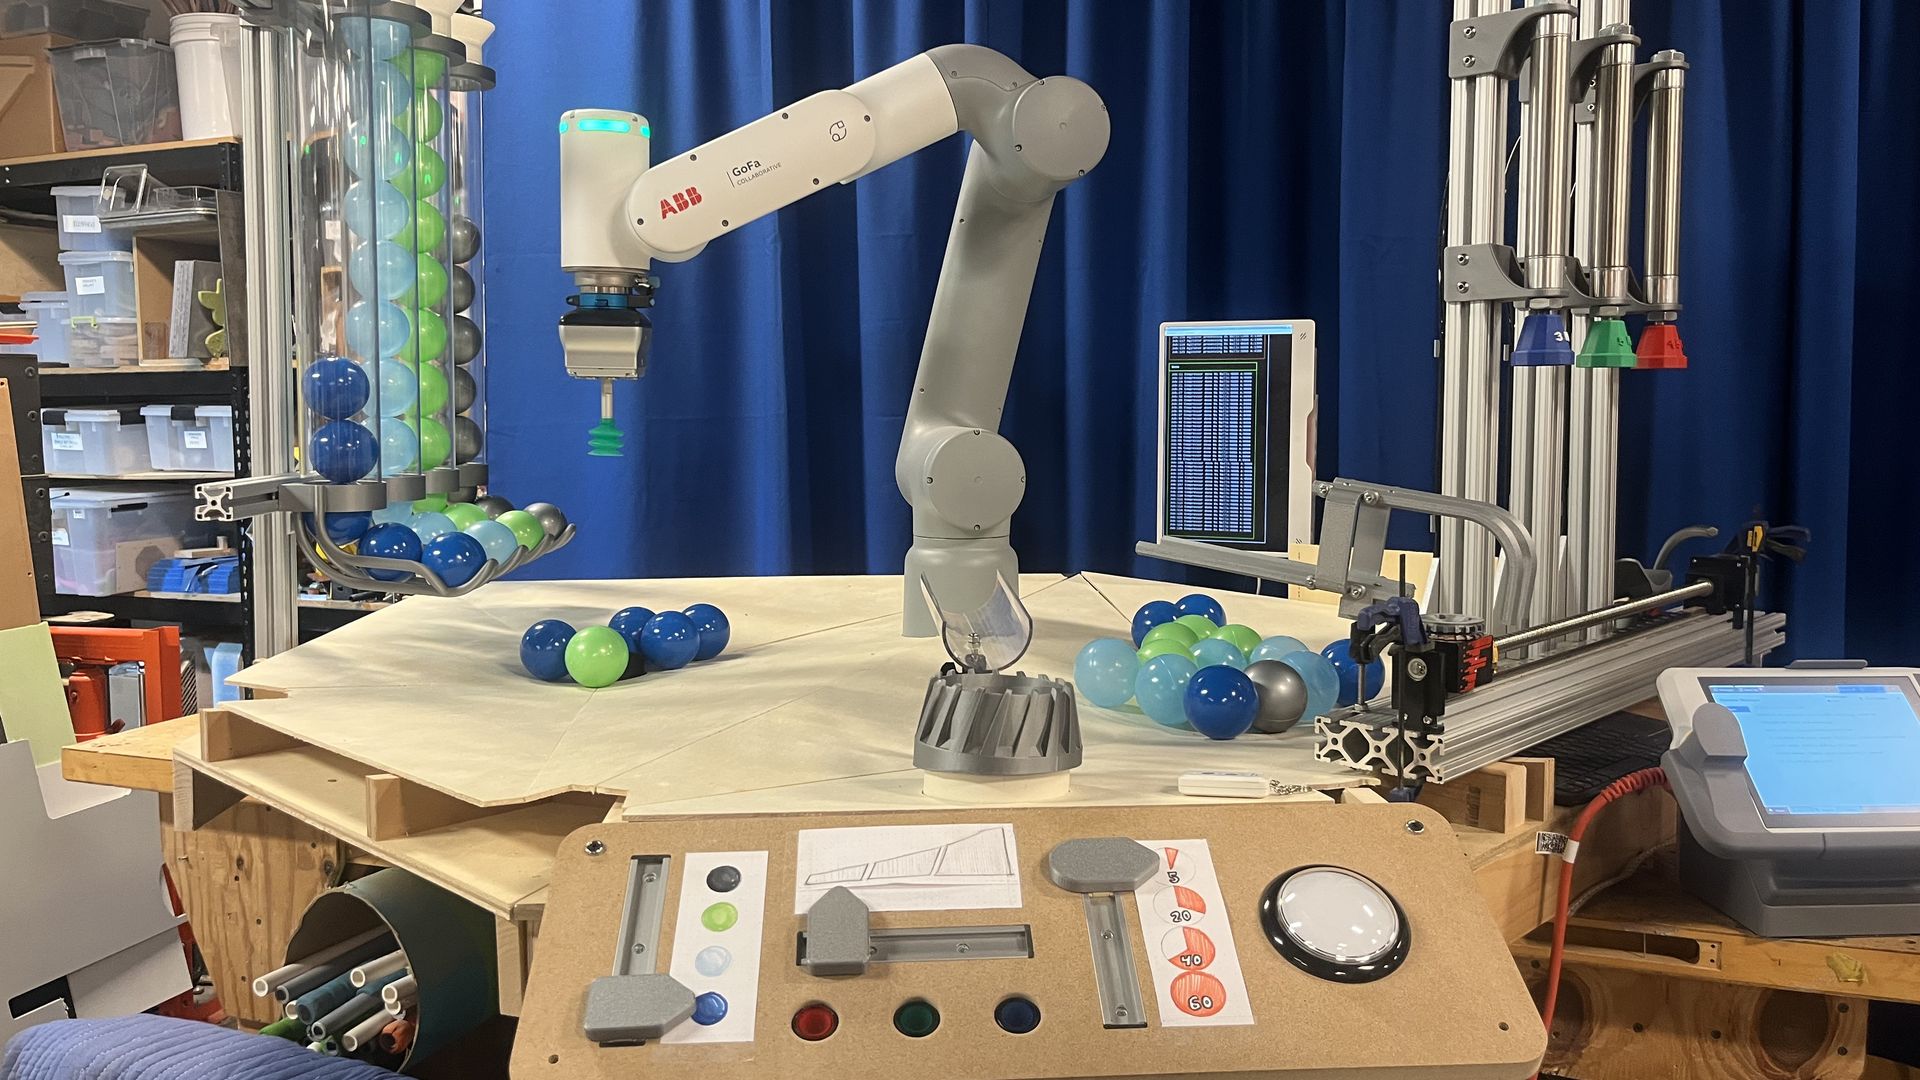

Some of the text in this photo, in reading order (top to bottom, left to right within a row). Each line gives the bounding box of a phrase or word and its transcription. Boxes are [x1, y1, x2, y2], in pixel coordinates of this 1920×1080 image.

[732, 160, 761, 177] GoFa
[737, 162, 781, 186] COLLABORATIVE
[660, 186, 702, 220] ABB
[1167, 871, 1180, 884] 5
[1170, 910, 1192, 923] 20
[1180, 954, 1203, 967] 40
[1187, 994, 1214, 1011] 60
